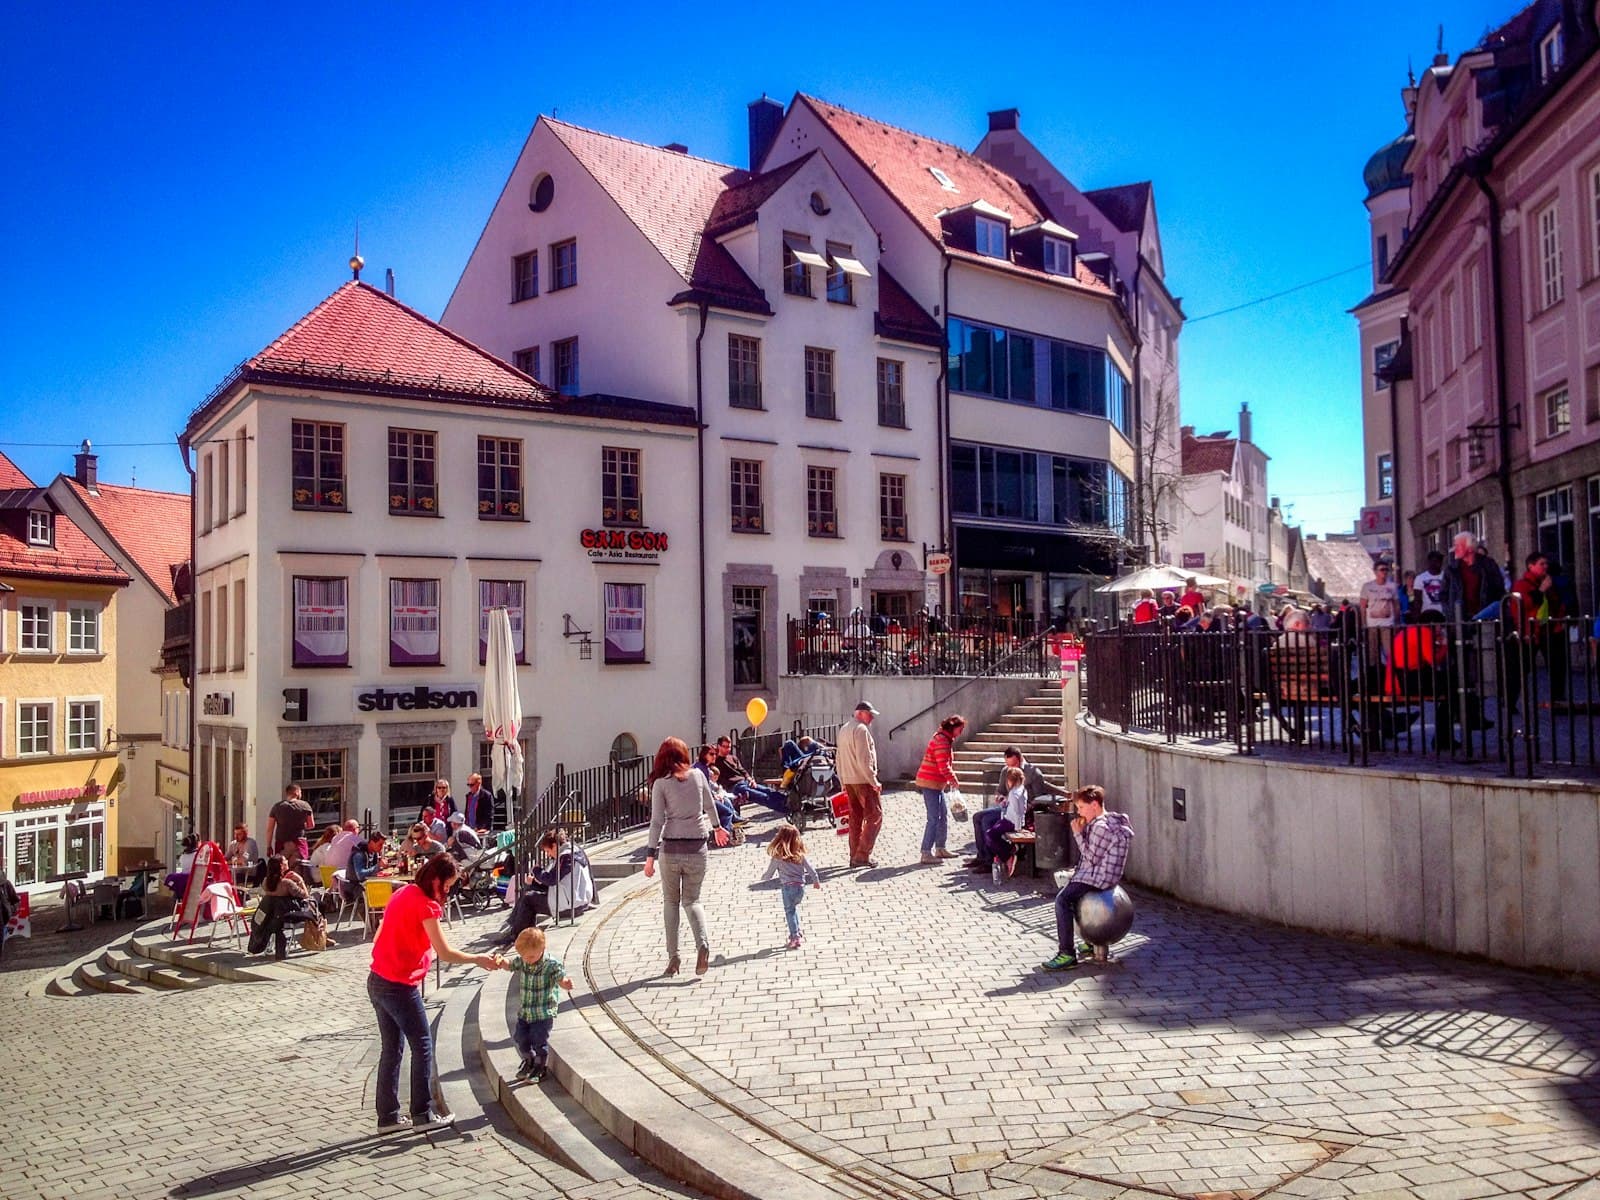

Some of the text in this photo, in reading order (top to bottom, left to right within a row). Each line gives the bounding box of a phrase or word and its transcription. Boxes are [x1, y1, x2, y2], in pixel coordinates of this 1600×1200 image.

[581, 529, 668, 551] SAM SON
[357, 686, 478, 712] strellson
